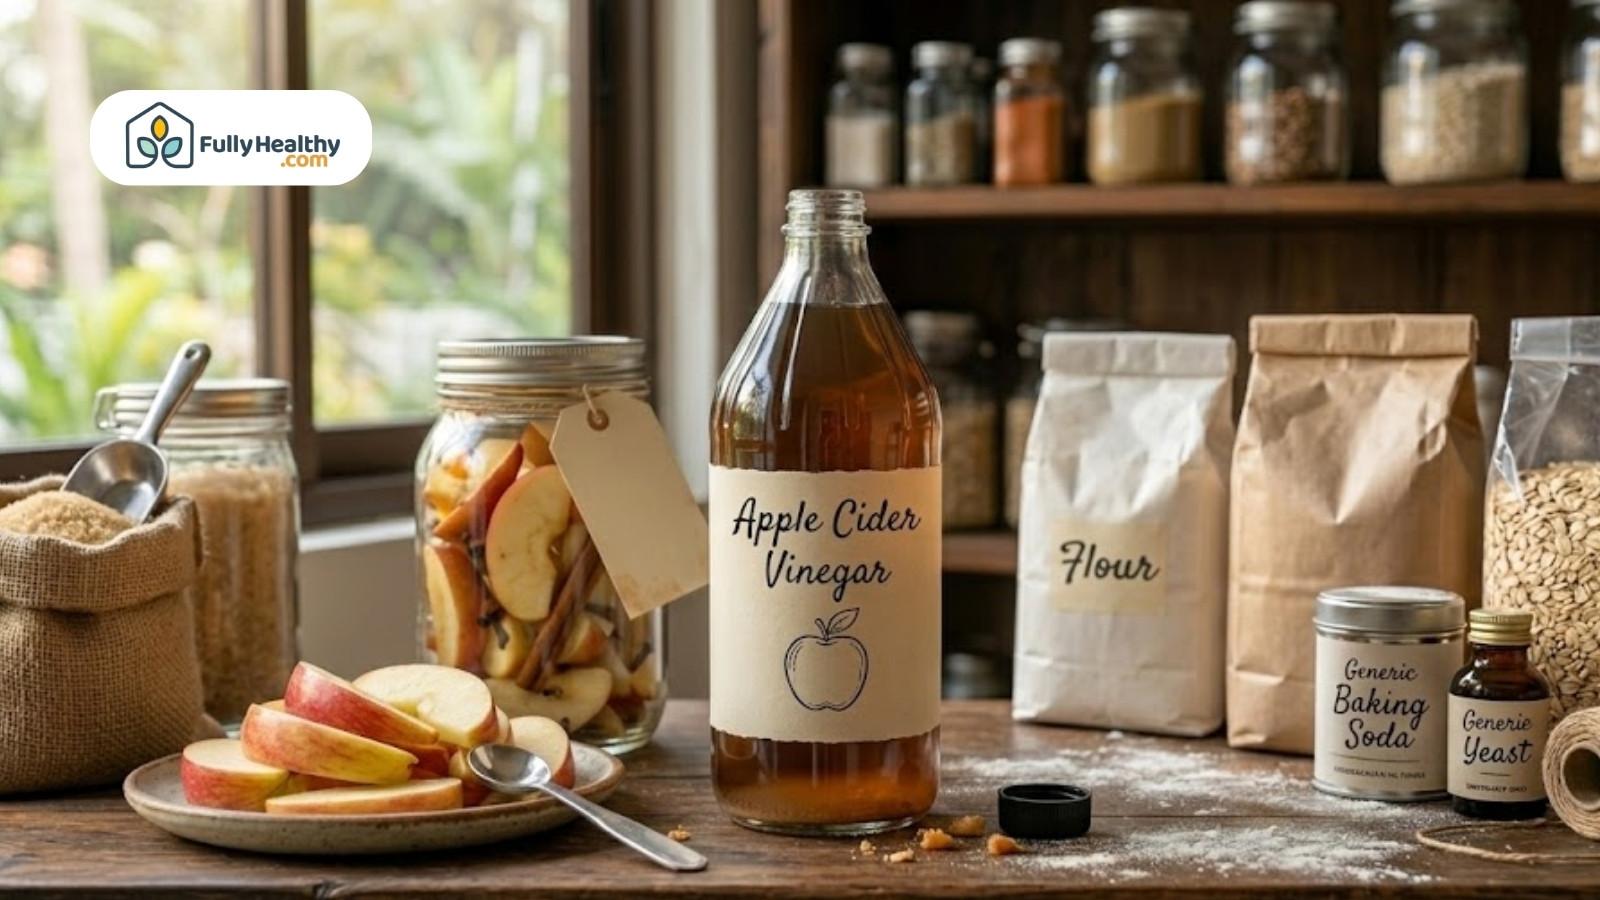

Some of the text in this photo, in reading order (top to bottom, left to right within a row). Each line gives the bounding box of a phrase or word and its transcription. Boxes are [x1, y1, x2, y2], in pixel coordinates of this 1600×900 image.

[732, 497, 921, 547] Apple Cider
[765, 550, 892, 602] Vinegar
[1060, 539, 1161, 585] Flour
[1344, 658, 1418, 681] Generic
[1333, 683, 1430, 731] Baking
[1344, 718, 1416, 750] Soda
[1463, 736, 1533, 765] Yeast
